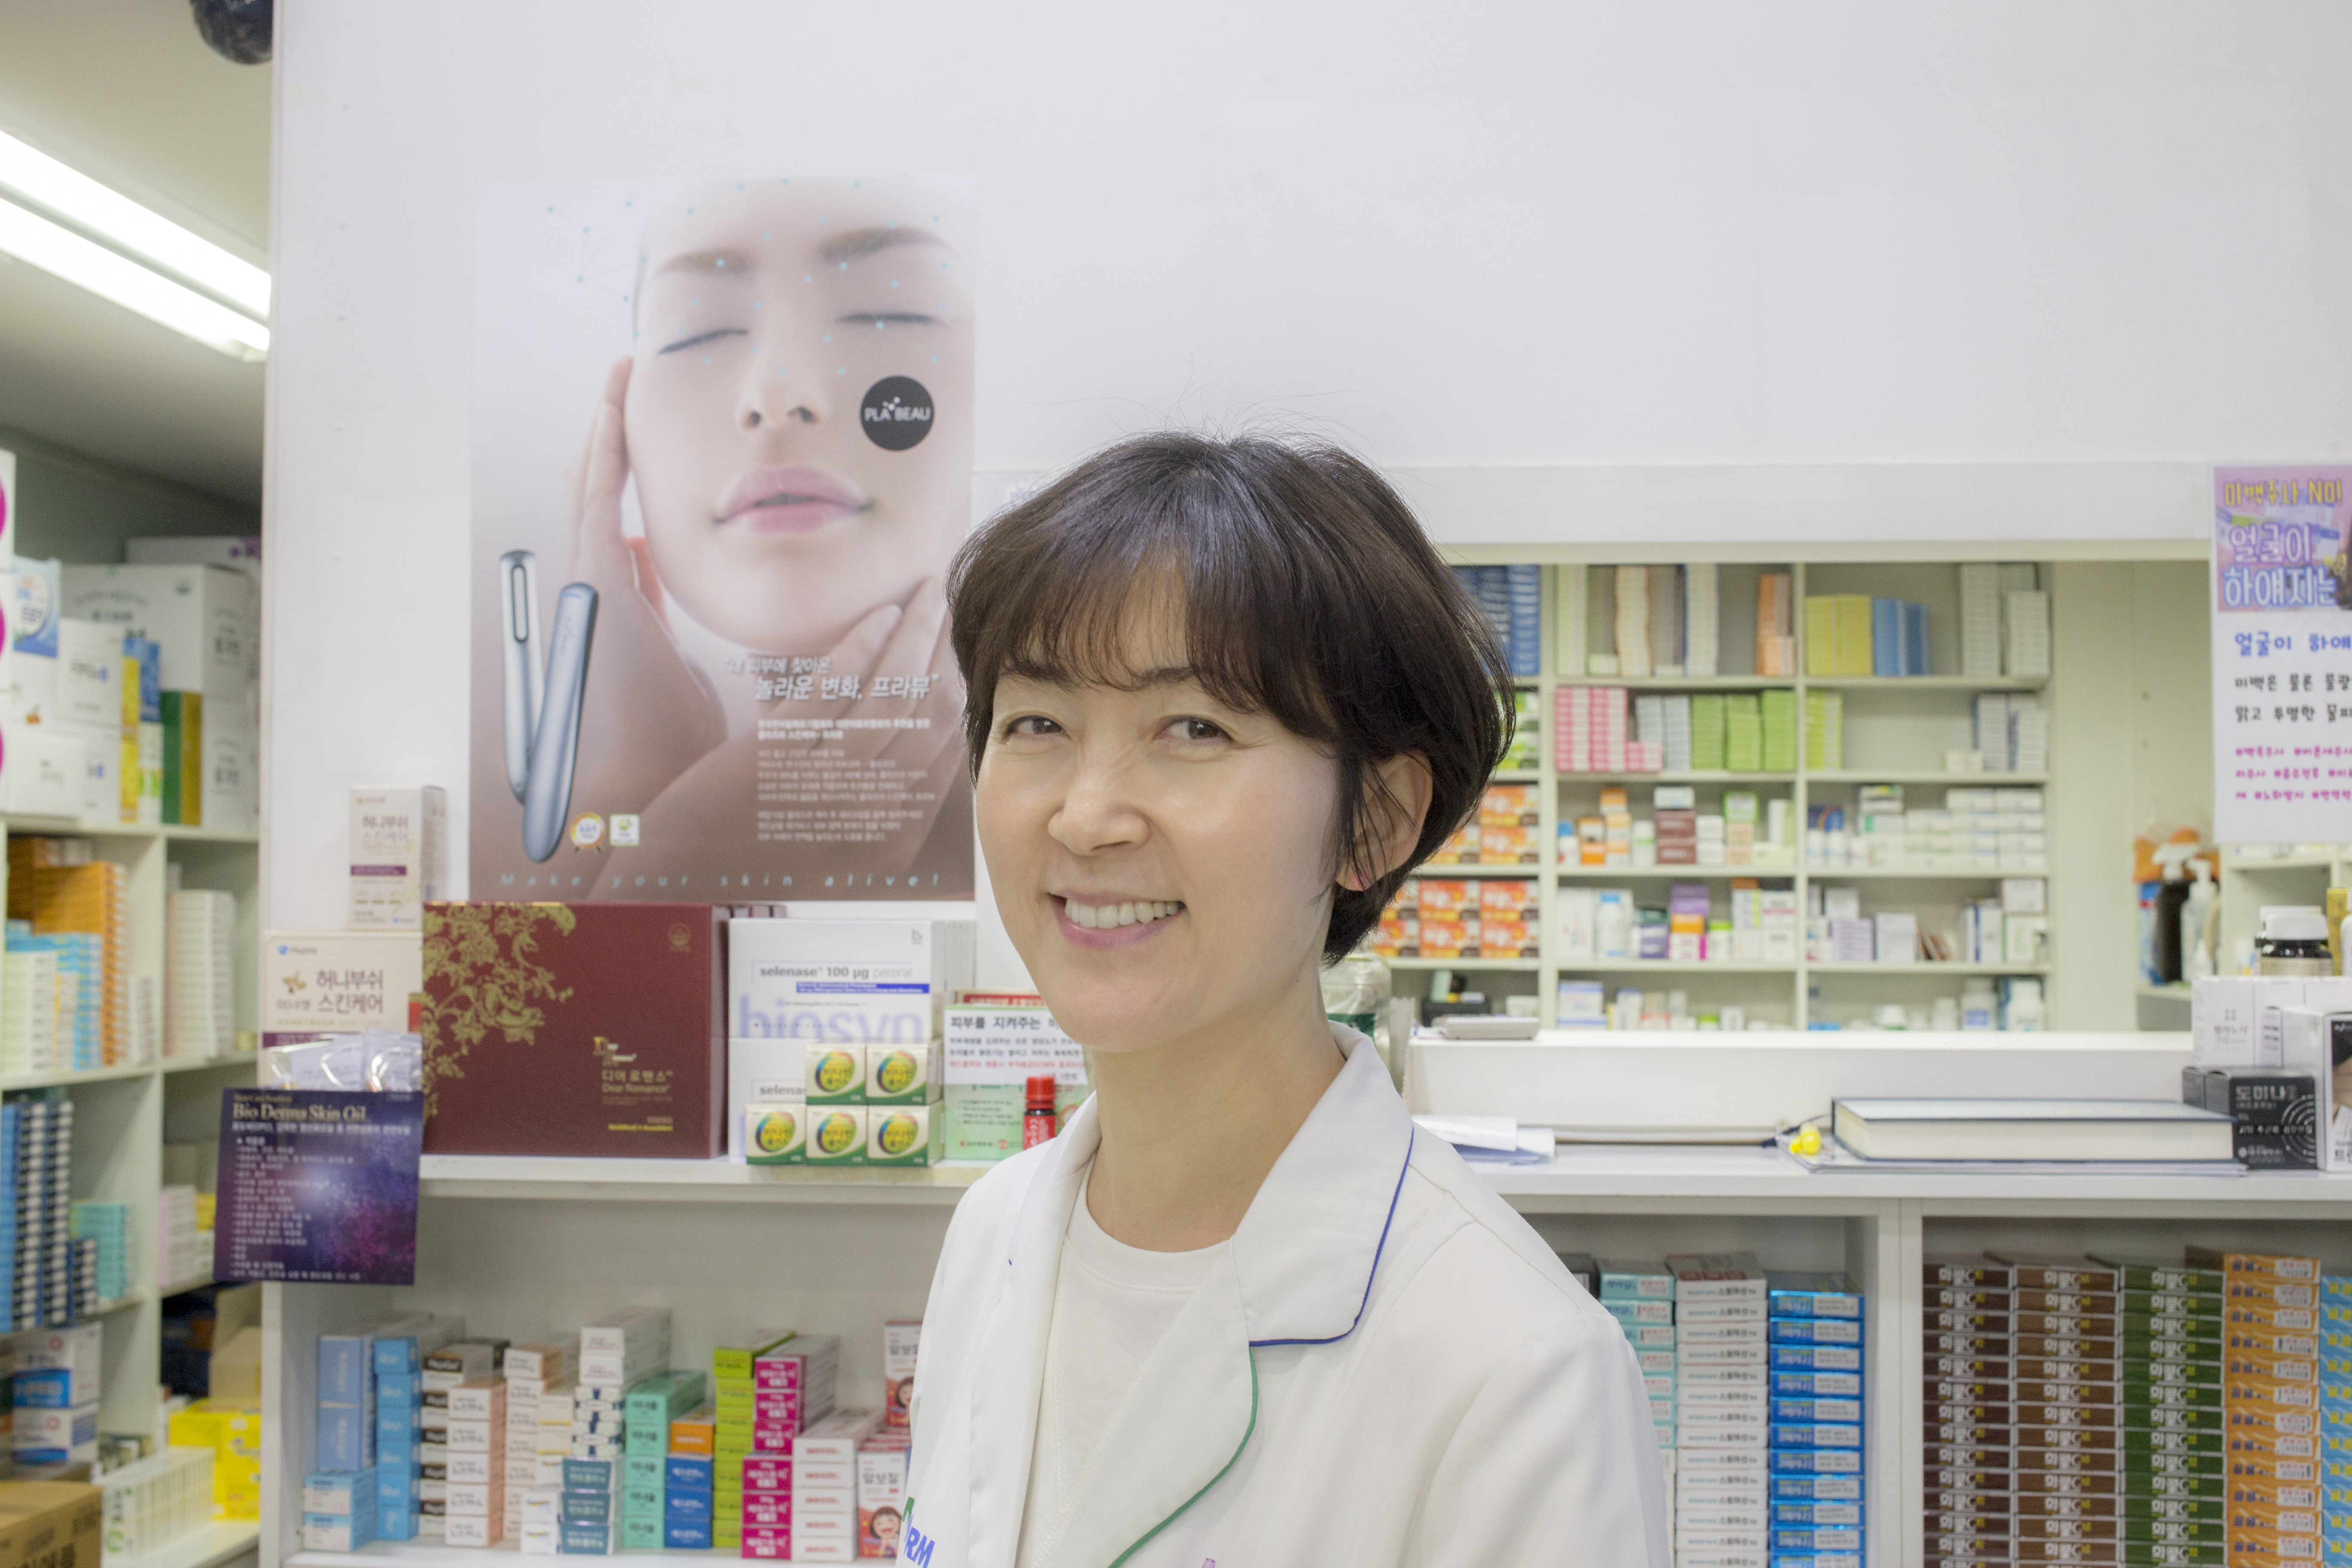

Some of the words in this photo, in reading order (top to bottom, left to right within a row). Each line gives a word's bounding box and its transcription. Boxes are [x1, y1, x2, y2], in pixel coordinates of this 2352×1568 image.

[2224, 479, 2300, 506] 미백주사
[2308, 478, 2342, 505] NO!
[2230, 523, 2311, 563] 얼굴이
[2235, 631, 2291, 657] 얼굴이
[755, 675, 814, 701] 놀라운
[2235, 674, 2277, 692] 미백은
[500, 873, 581, 886] Make
[612, 874, 689, 889] your
[719, 872, 793, 886] skin
[824, 871, 940, 887] alive!
[316, 969, 383, 990] 허니부쉬
[827, 966, 850, 978] 100
[873, 965, 912, 980] peroral
[317, 992, 383, 1015] 스킨케어
[951, 1016, 985, 1029] 피부를
[994, 1016, 1041, 1030] 지켜주는
[233, 1102, 259, 1120] Bio
[261, 1103, 308, 1120] Derma
[309, 1104, 341, 1121] Skin
[343, 1105, 367, 1122] Oil
